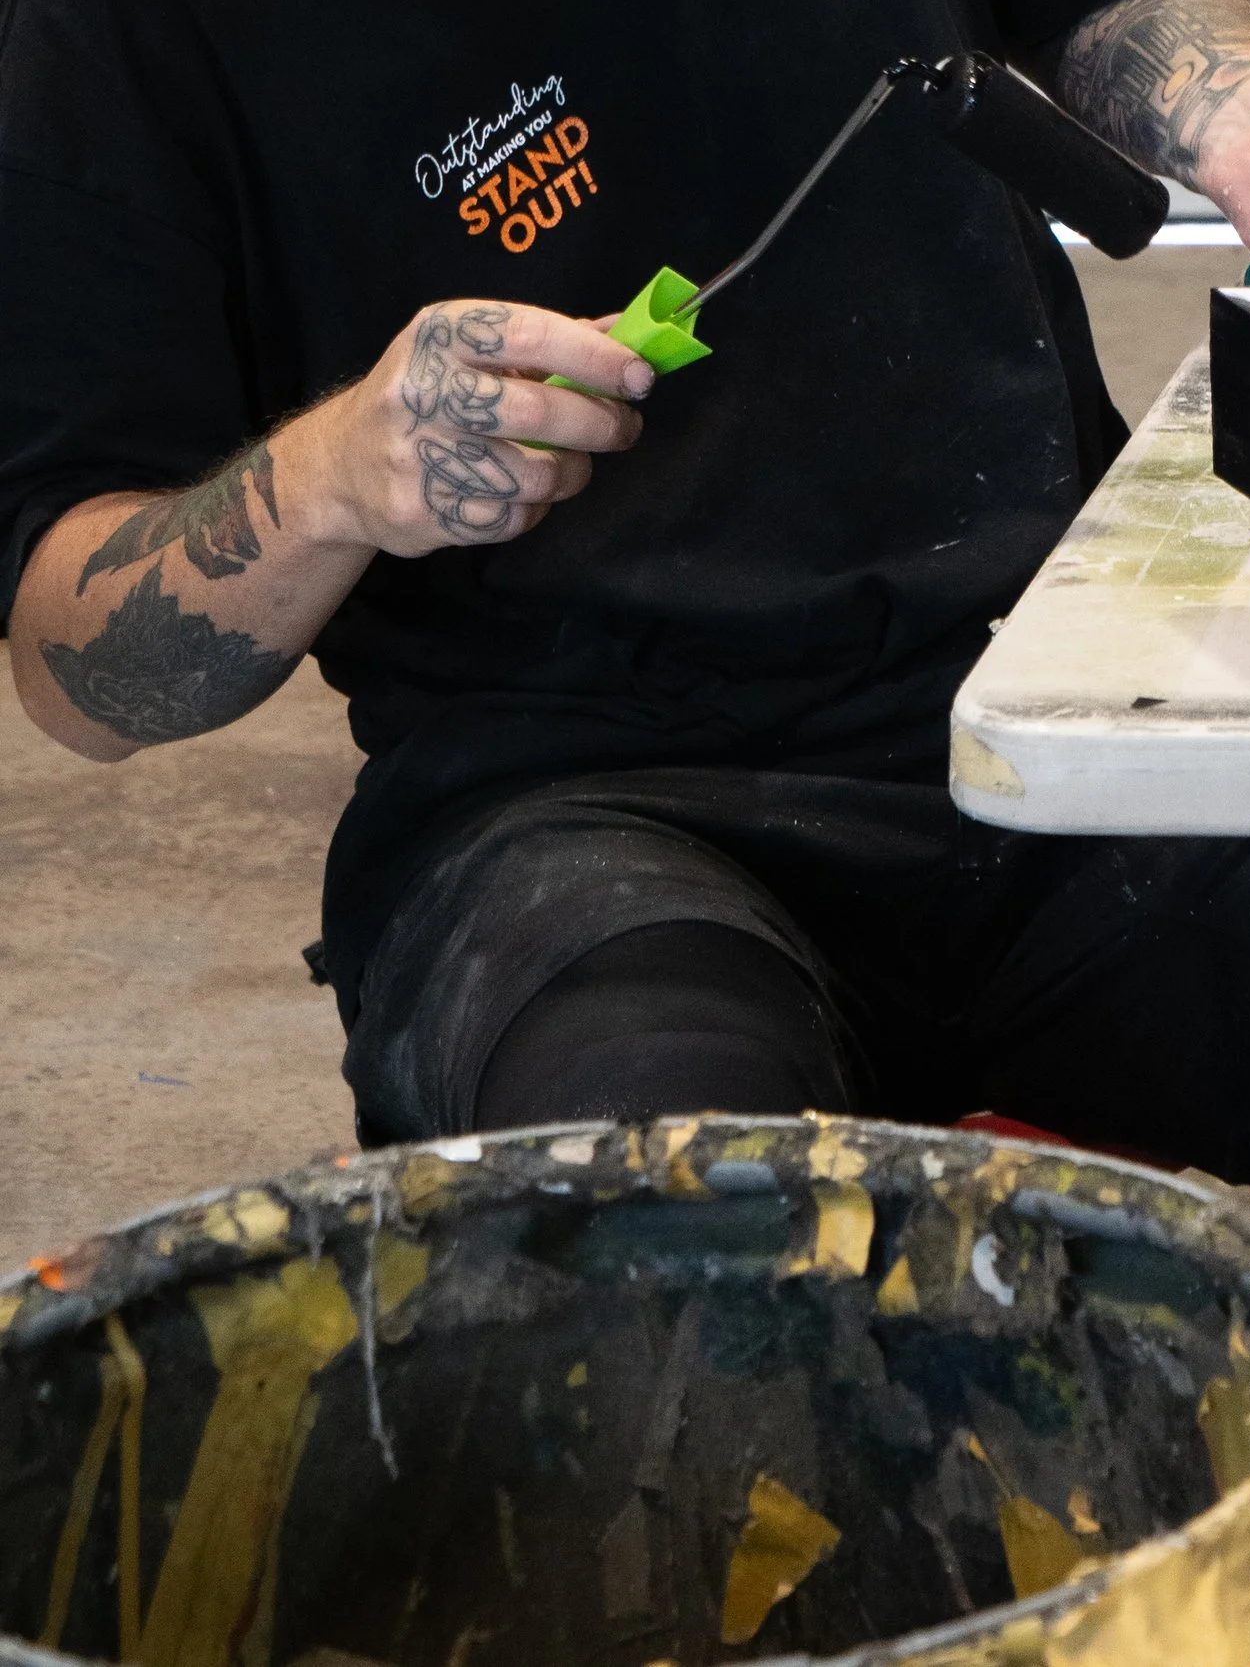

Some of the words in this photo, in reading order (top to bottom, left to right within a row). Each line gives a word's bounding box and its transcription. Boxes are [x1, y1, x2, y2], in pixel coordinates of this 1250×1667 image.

[416, 75, 565, 199] Outstanding
[459, 116, 589, 235] STAND
[461, 174, 476, 193] AT
[478, 133, 526, 179] MAKING
[524, 110, 552, 138] YOU
[501, 159, 598, 253] OUT!
